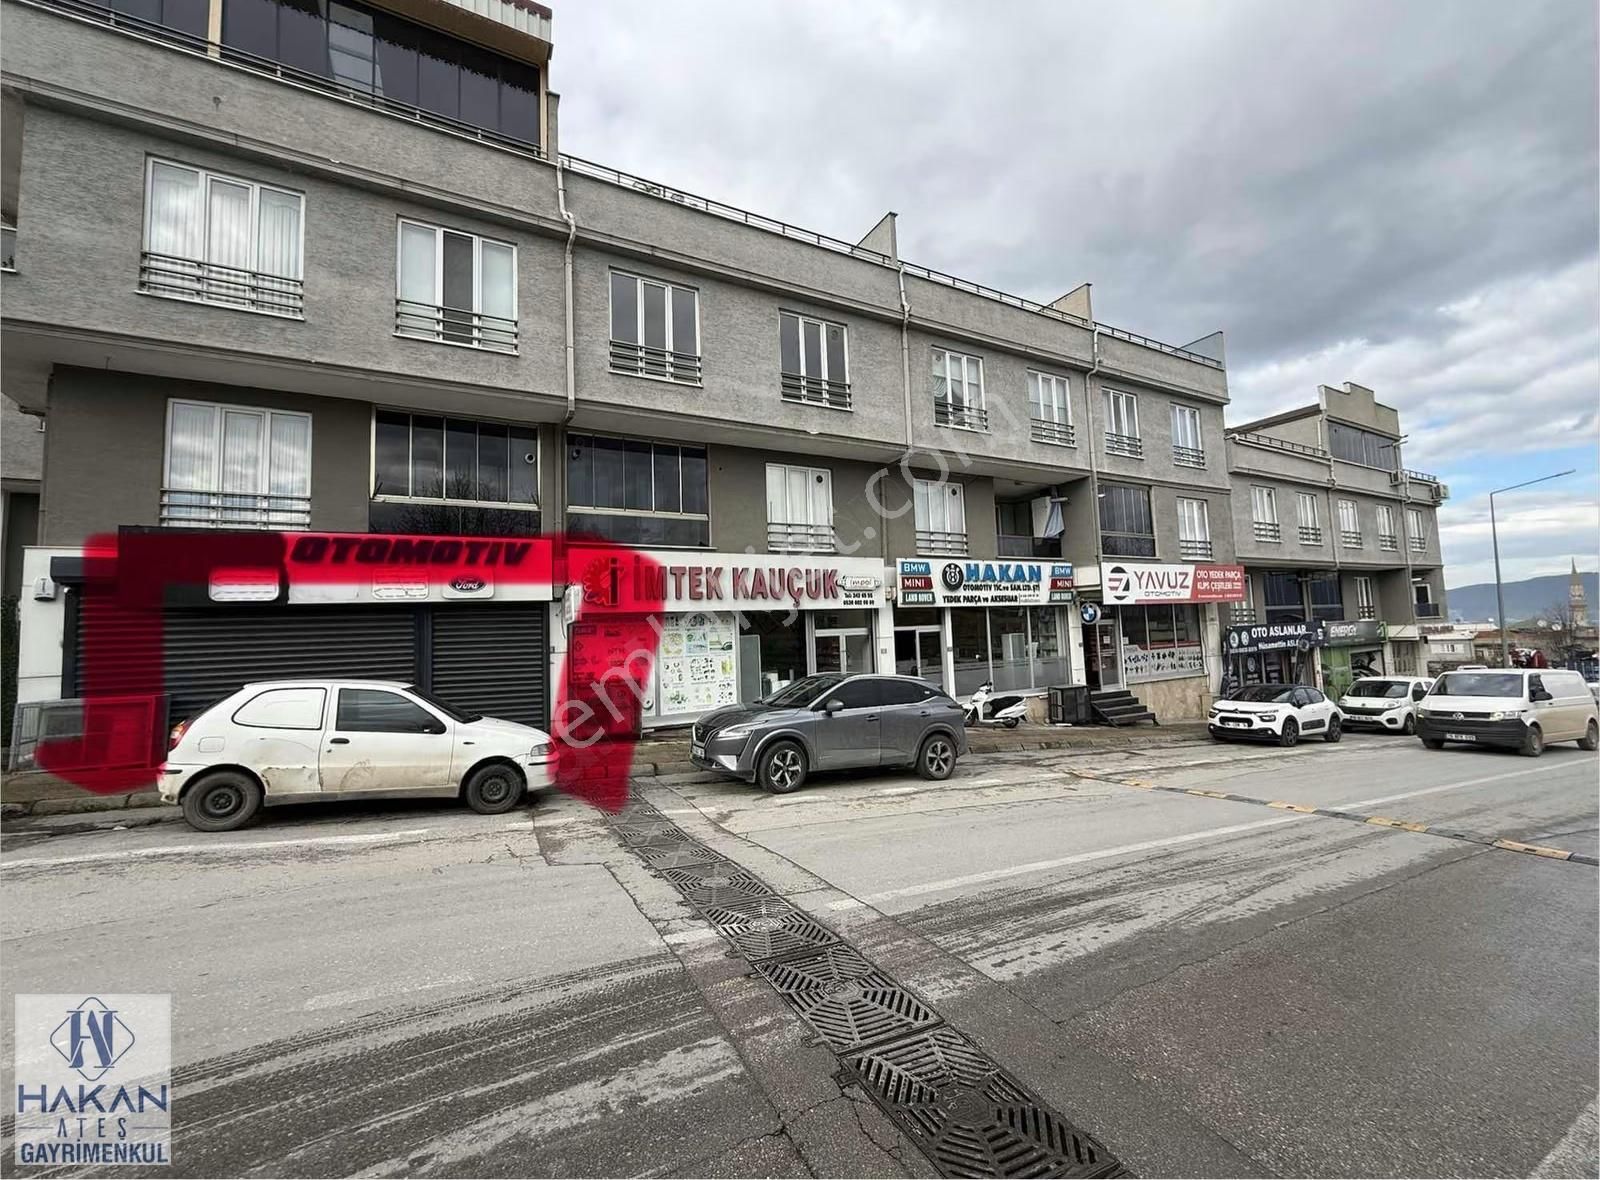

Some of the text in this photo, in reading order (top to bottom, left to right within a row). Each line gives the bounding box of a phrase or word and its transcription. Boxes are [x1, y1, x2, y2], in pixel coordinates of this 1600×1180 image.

[903, 563, 926, 572] BMW
[965, 563, 1042, 583] HAKAN
[1054, 567, 1071, 575] BMW
[633, 554, 839, 608] İMTEK KAUÇUK
[1134, 571, 1189, 590] YAVUZ
[1196, 570, 1241, 581] OTO YEDEK PARÇA
[455, 579, 480, 591] Ford
[904, 578, 925, 587] MINI
[1056, 580, 1072, 588] MINI
[942, 595, 962, 603] YEDEK
[962, 595, 981, 605] PARÇA
[1251, 624, 1306, 638] OTO ASLANLAR
